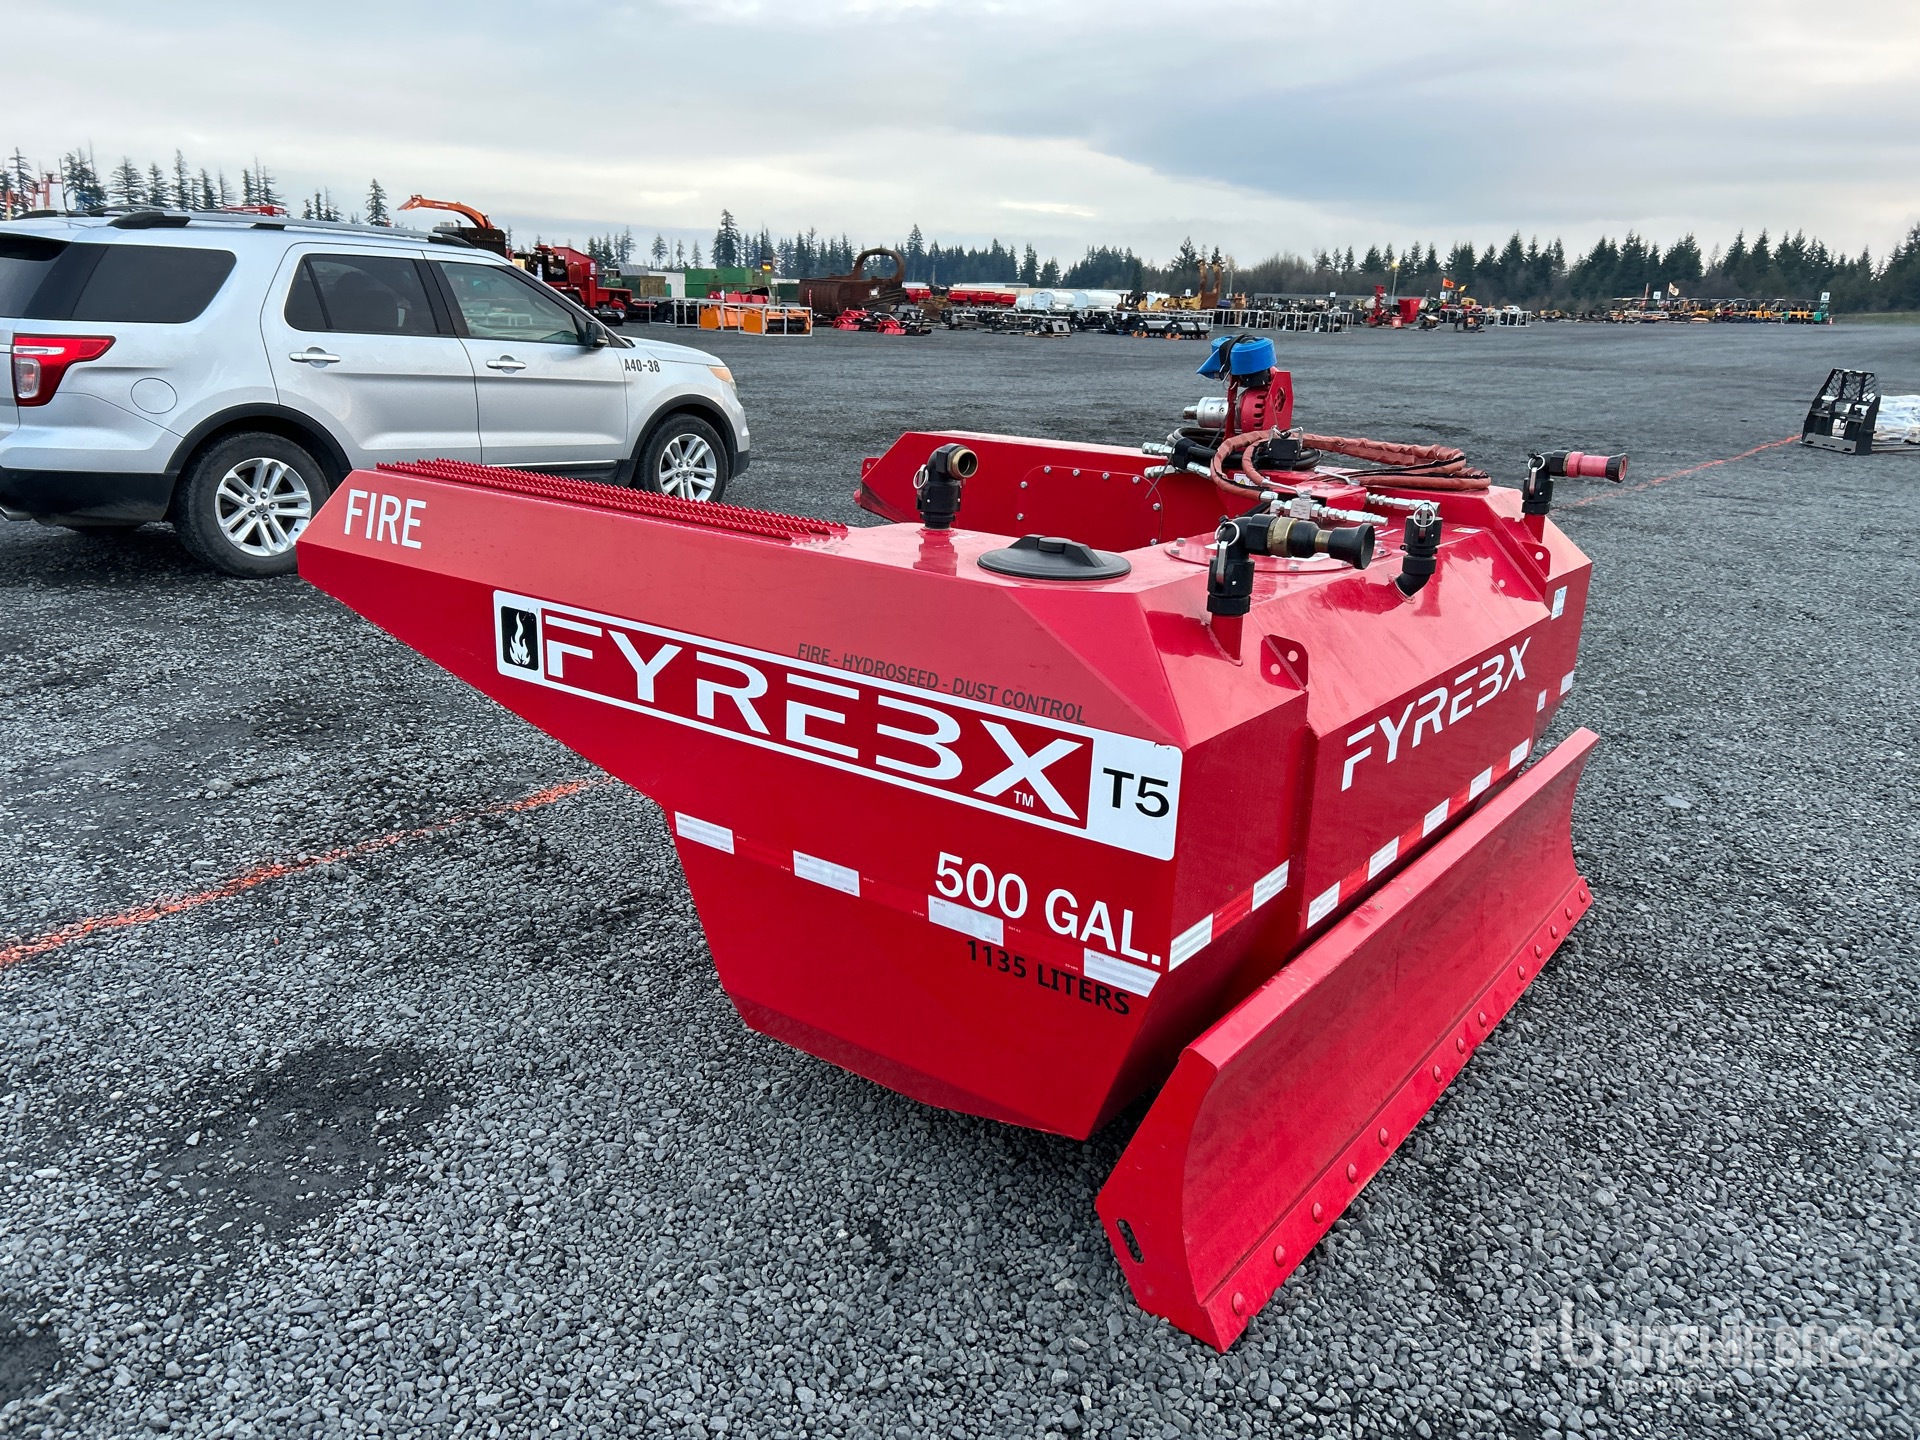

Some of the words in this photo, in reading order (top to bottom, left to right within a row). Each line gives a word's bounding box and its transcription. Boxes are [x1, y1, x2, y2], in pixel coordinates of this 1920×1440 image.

[624, 358, 660, 373] A40-38
[344, 488, 427, 550] FIRE
[797, 642, 831, 666] FIRE
[842, 652, 939, 689] HYDROSEED
[952, 677, 998, 703] DUST
[1001, 688, 1086, 724] CONTROL
[1103, 767, 1170, 818] T5
[935, 851, 1028, 919] 500
[1045, 888, 1161, 967] GAL.
[967, 940, 1027, 979] 1135
[1038, 963, 1130, 1015] LITERS
